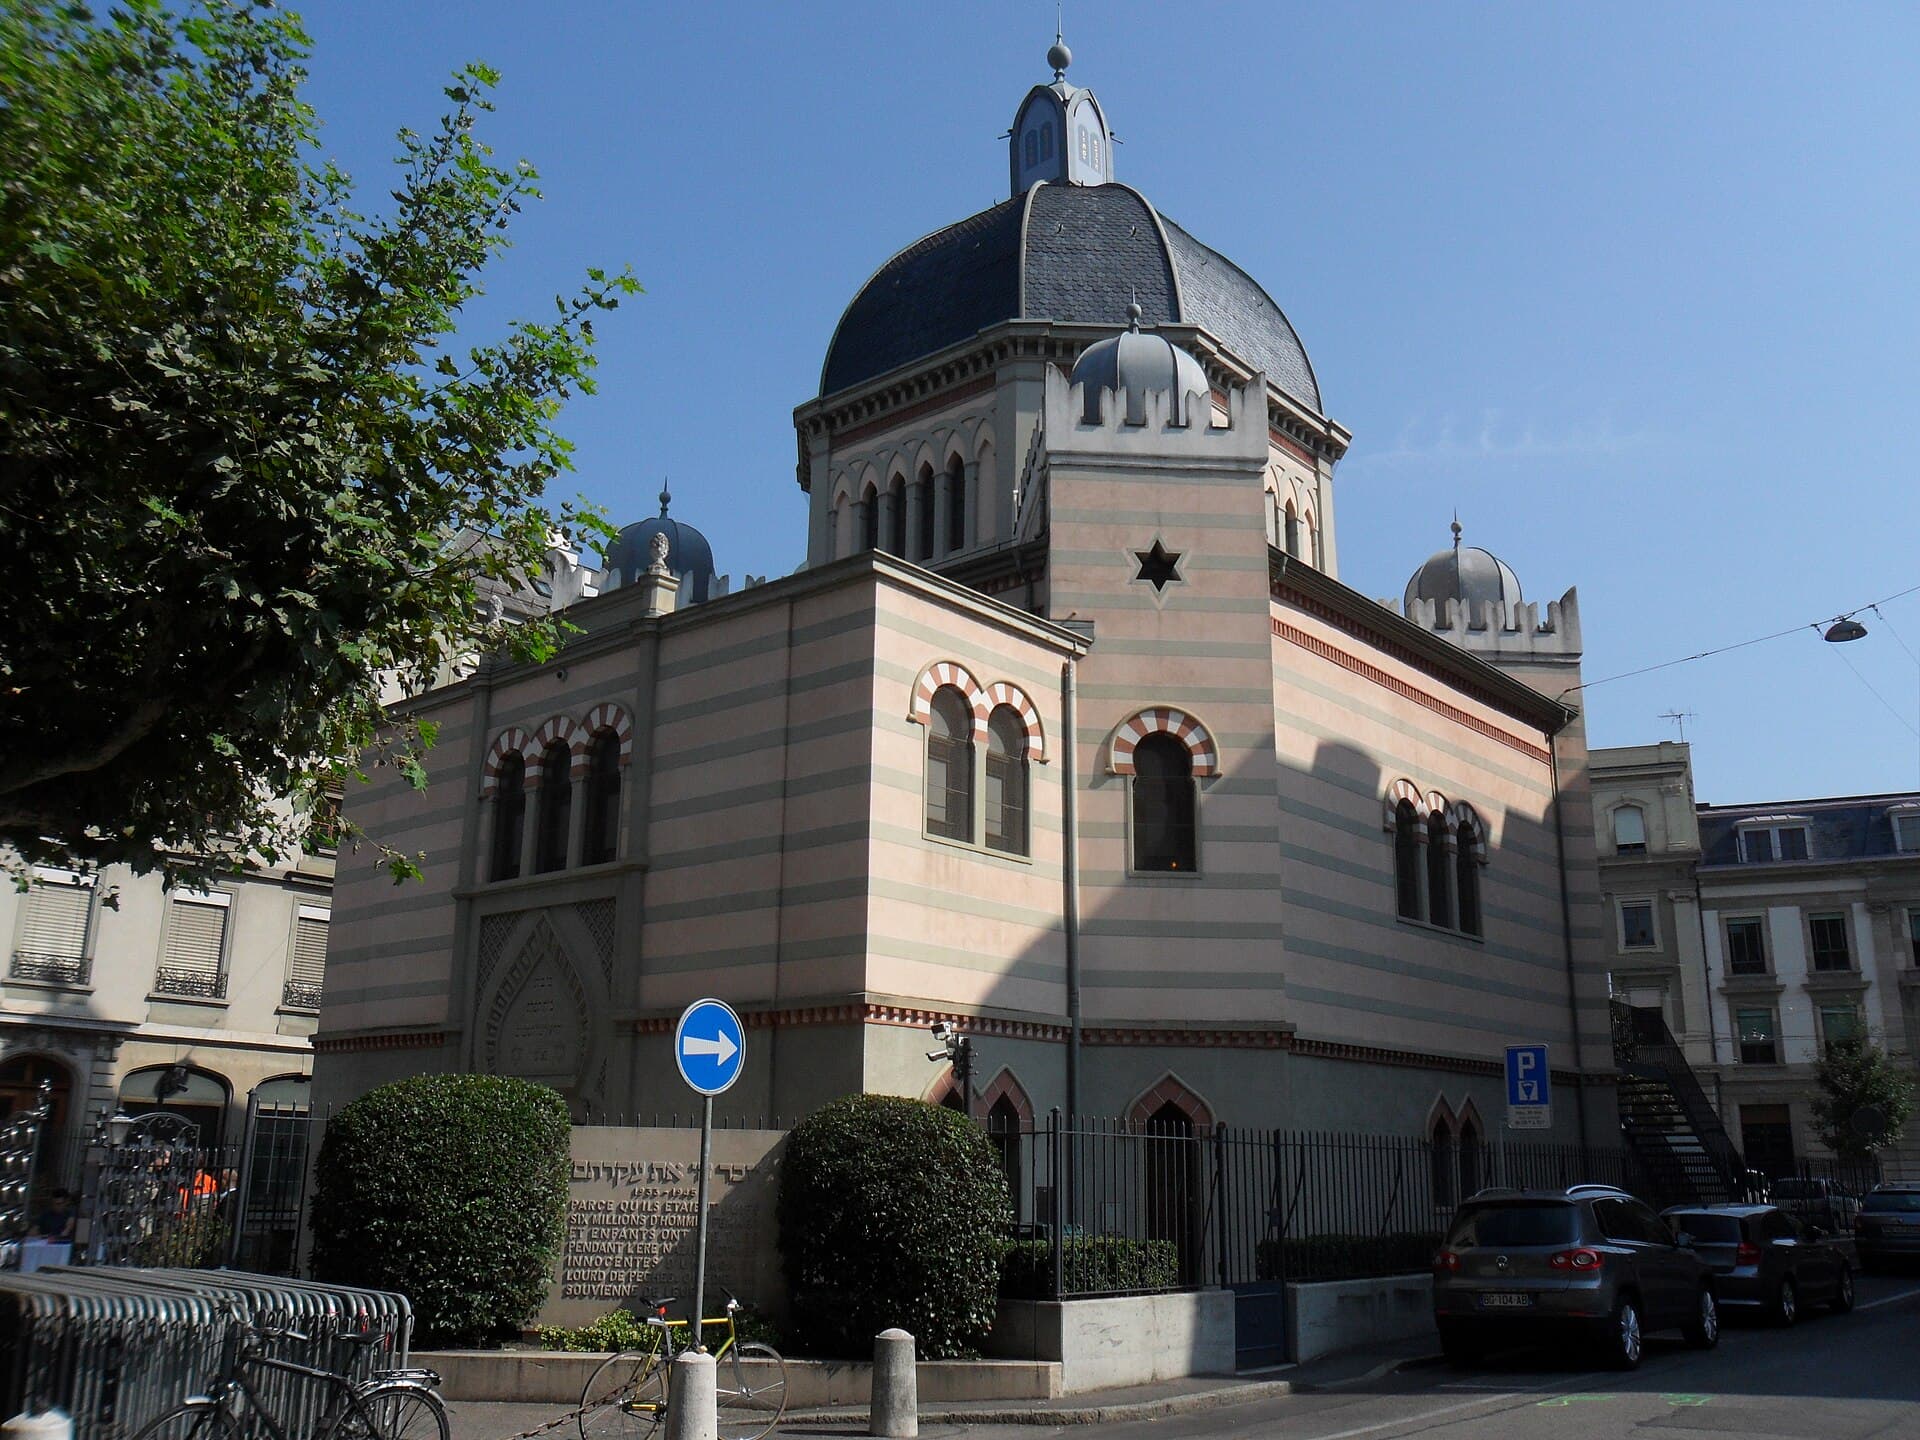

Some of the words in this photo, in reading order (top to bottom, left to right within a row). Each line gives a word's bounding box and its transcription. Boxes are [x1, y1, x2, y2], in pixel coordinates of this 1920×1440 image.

[1517, 1052, 1535, 1079] P
[569, 1200, 614, 1212] PARCE
[569, 1214, 588, 1226] SIX
[592, 1214, 646, 1227] MILLIONS
[569, 1228, 586, 1240] ET
[591, 1228, 656, 1241] ENFANTS
[661, 1229, 690, 1242] ONT
[568, 1242, 623, 1254] PENDANT
[567, 1256, 660, 1269] INNOCENTES
[566, 1270, 606, 1283] LOURD
[610, 1271, 624, 1283] DE
